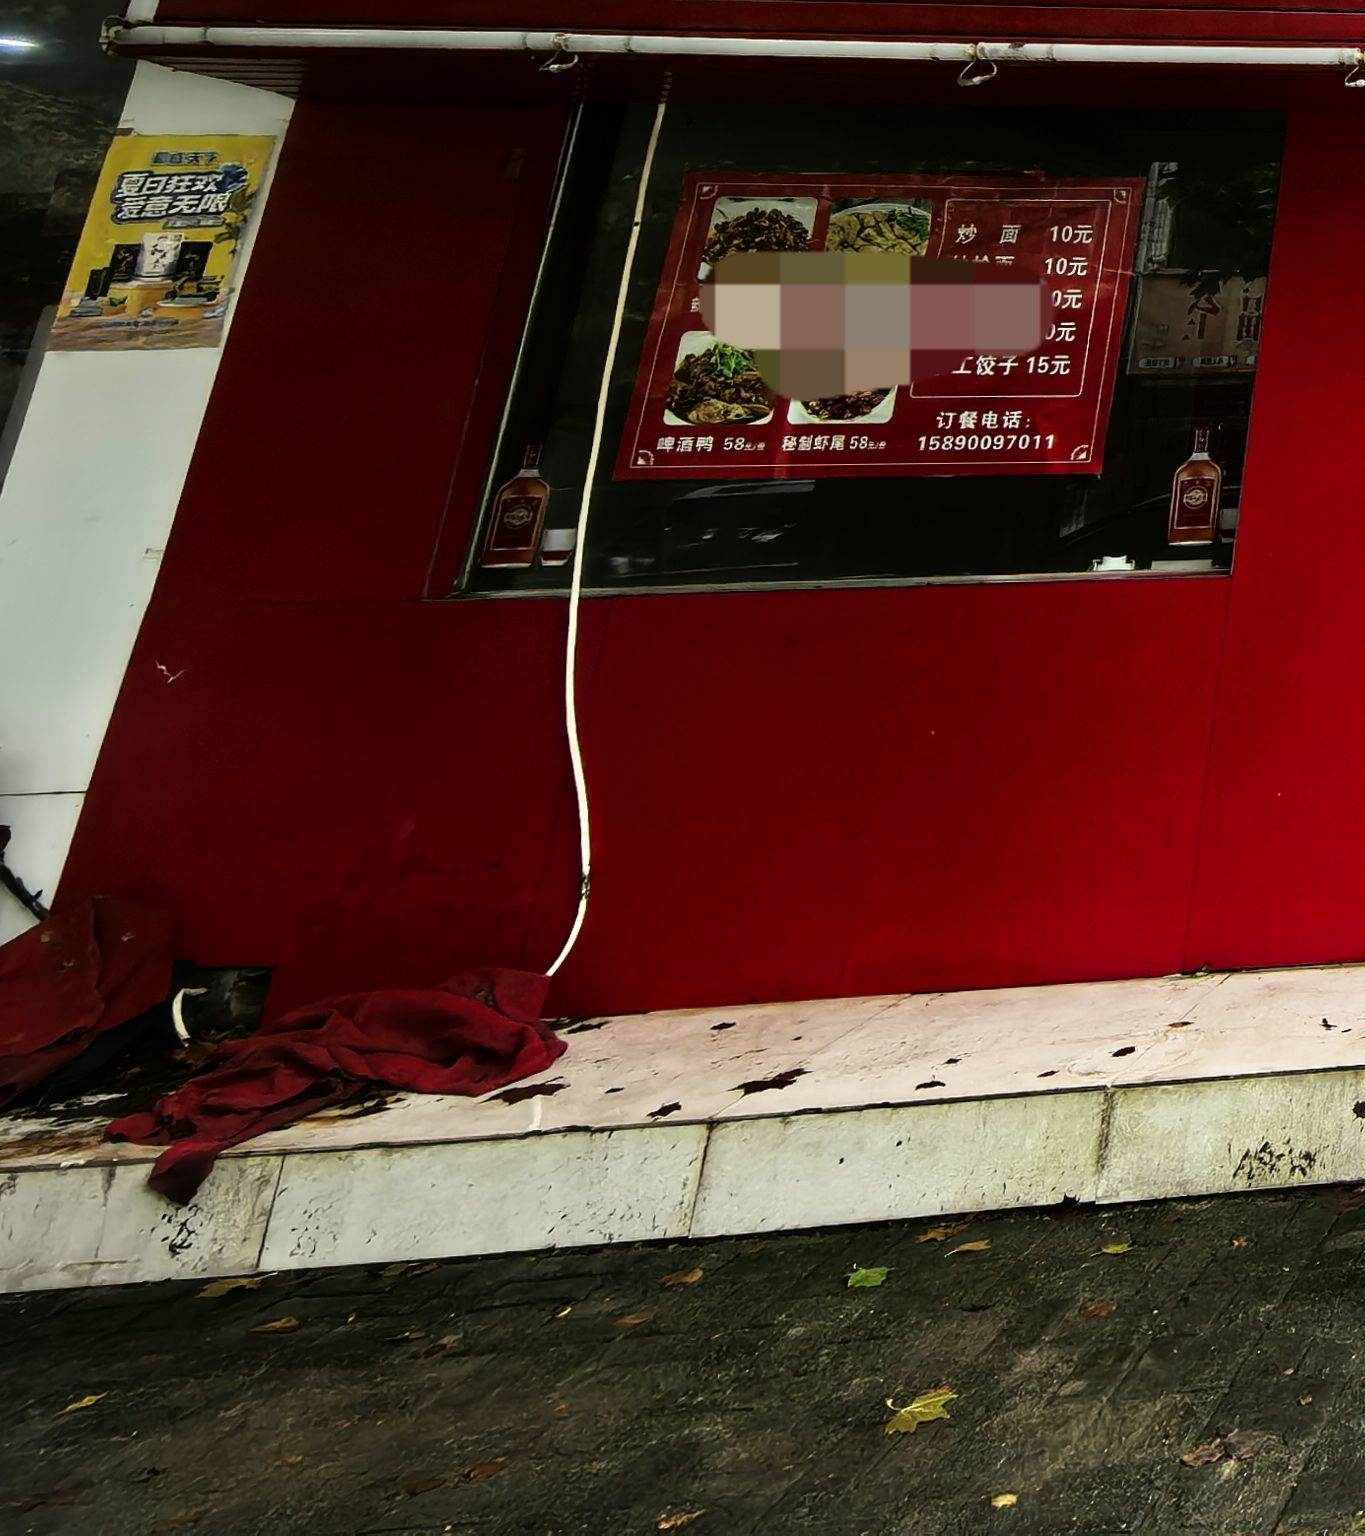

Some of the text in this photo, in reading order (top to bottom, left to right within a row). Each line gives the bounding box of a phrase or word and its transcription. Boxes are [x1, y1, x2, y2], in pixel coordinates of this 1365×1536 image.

[117, 172, 223, 198] 夏日狂欢
[117, 192, 233, 220] 爱意无限
[1050, 224, 1093, 244] 10元
[1044, 257, 1088, 276] 10元
[1052, 289, 1083, 310] 0元
[1026, 355, 1072, 375] 15元
[656, 435, 715, 453] 啤酒鸭
[917, 433, 1056, 452] 15890097011
